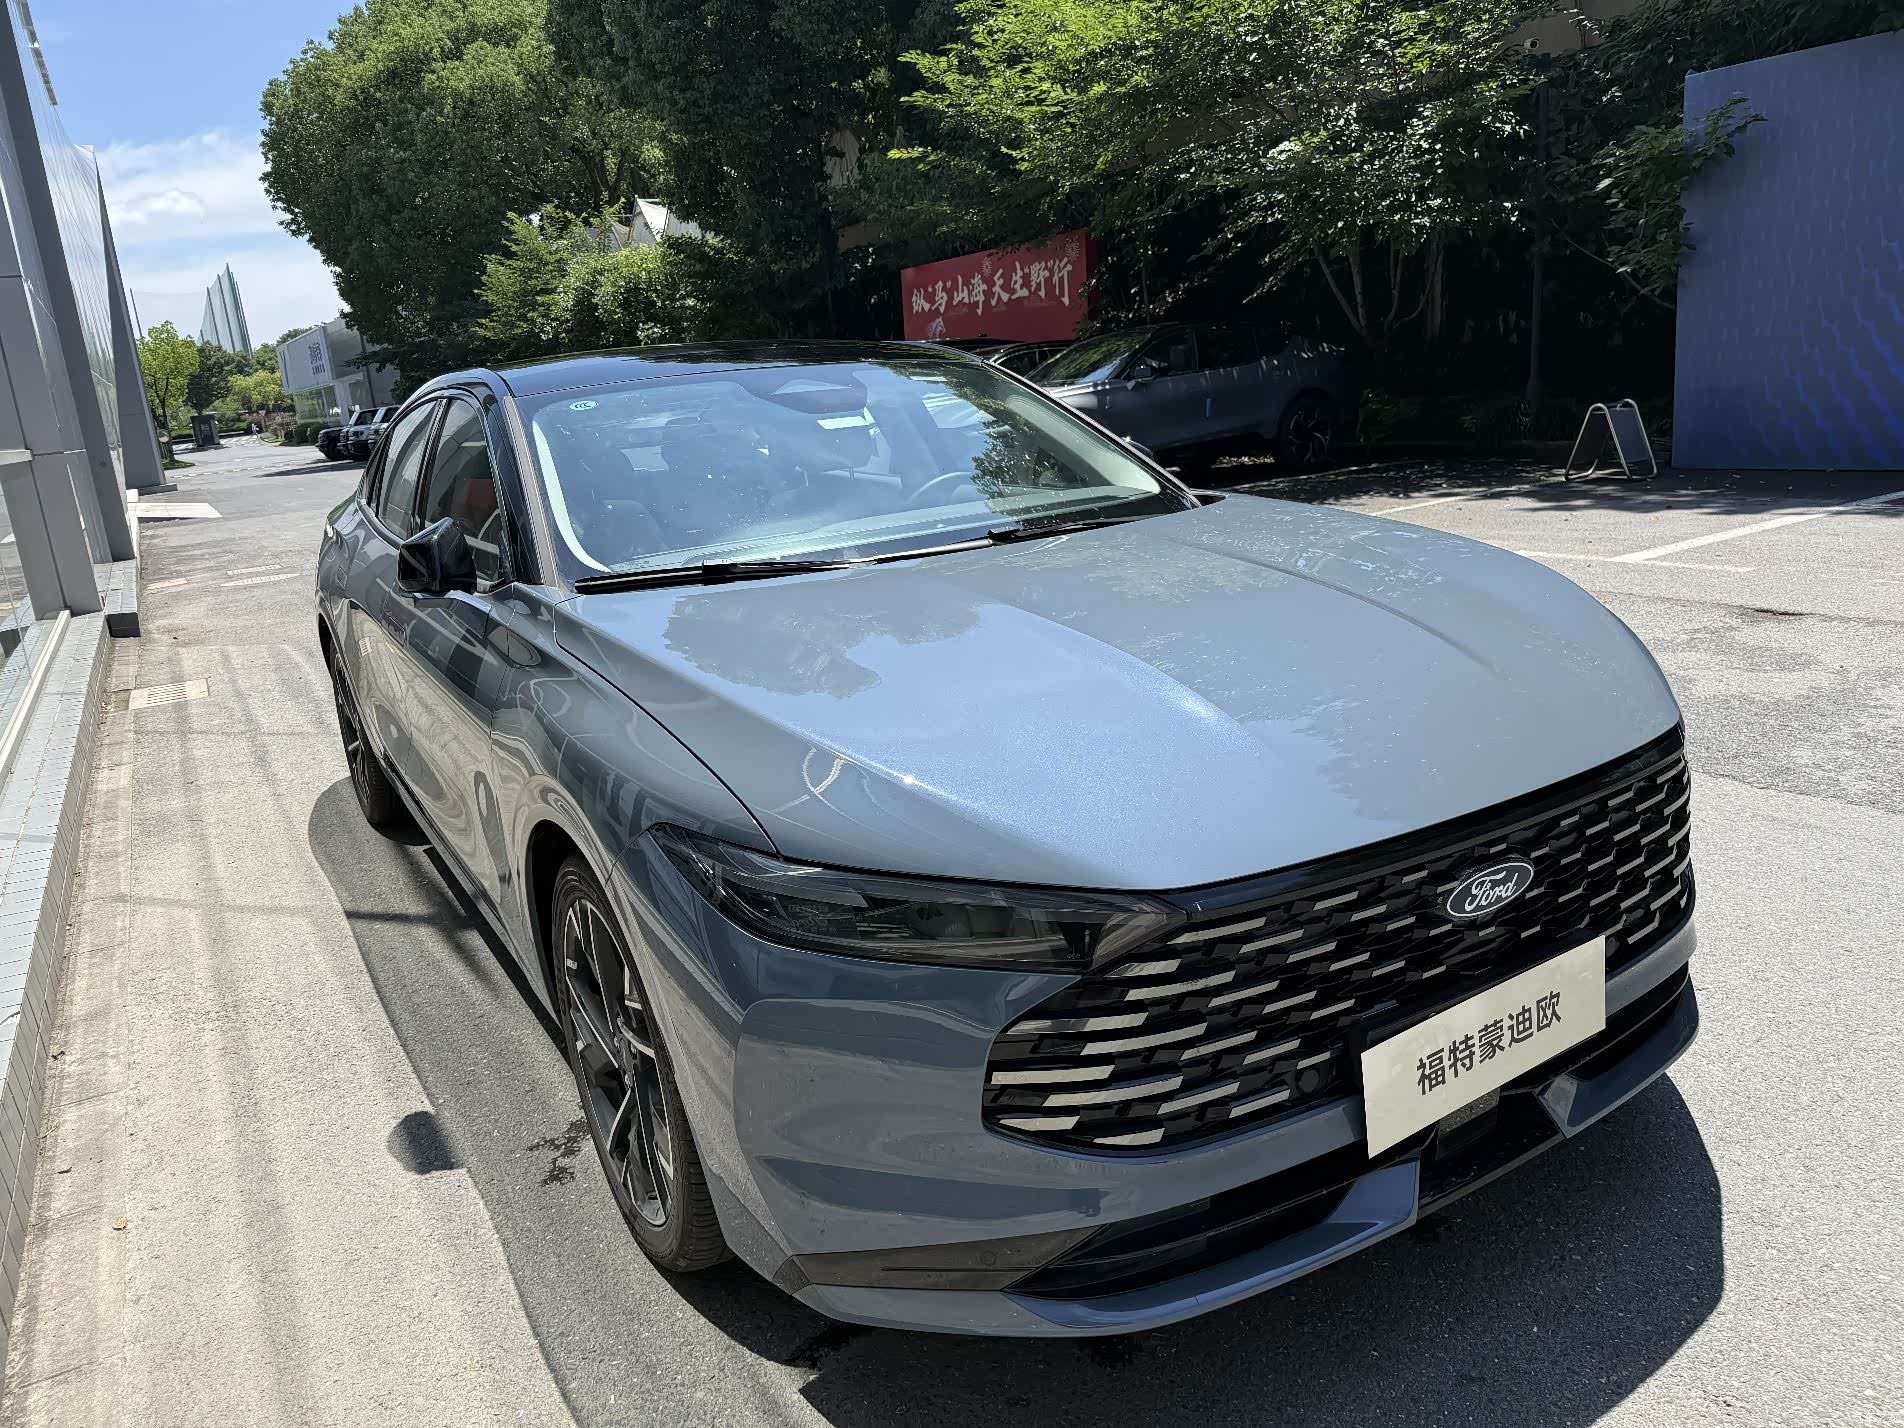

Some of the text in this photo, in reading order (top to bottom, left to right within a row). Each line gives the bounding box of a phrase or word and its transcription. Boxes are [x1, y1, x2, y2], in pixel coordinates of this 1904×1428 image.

[1464, 871, 1519, 912] Ford
[1416, 991, 1562, 1096] 福特蒙迪欧
